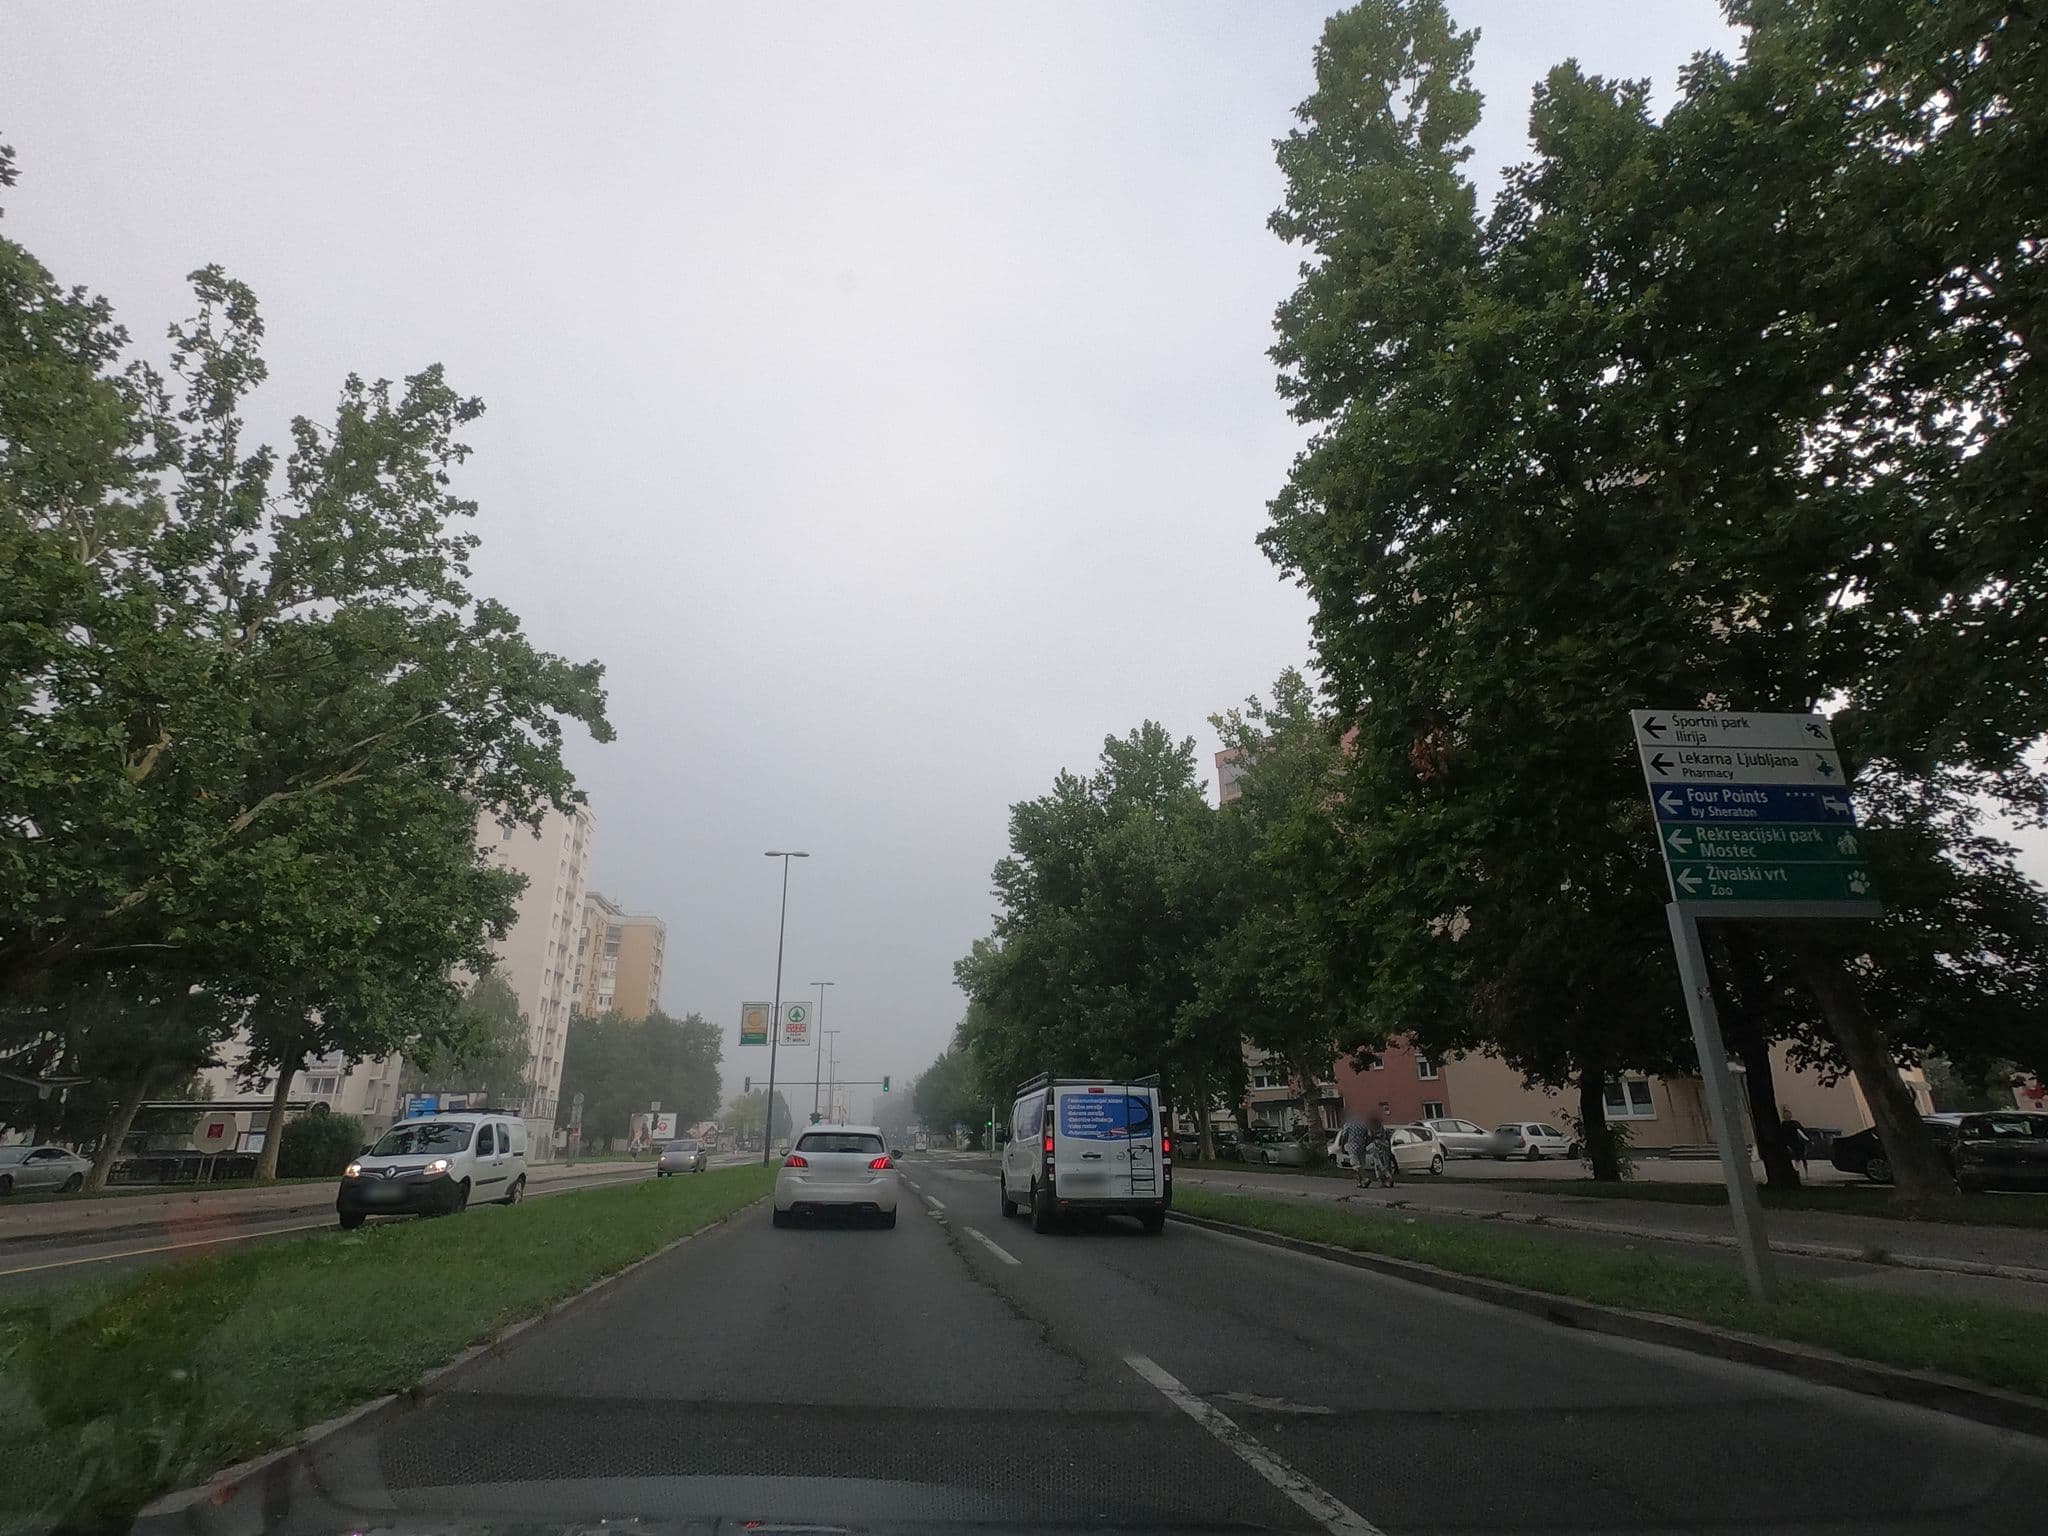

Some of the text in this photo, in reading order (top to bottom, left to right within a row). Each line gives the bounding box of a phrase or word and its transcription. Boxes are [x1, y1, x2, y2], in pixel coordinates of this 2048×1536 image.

[1672, 714, 1750, 731] Športni park
[1676, 731, 1708, 744] Ilirija
[1679, 752, 1800, 768] Lekarna Ljubljana
[1682, 768, 1734, 780] Pharmacy
[1686, 788, 1769, 804] Four Points
[1691, 806, 1758, 819] by Sheraton
[1696, 827, 1823, 844] Rekreacijski park
[1700, 844, 1757, 858] Mostec
[1706, 862, 1788, 881] Živalski vrt
[1710, 884, 1733, 896] Zoo
